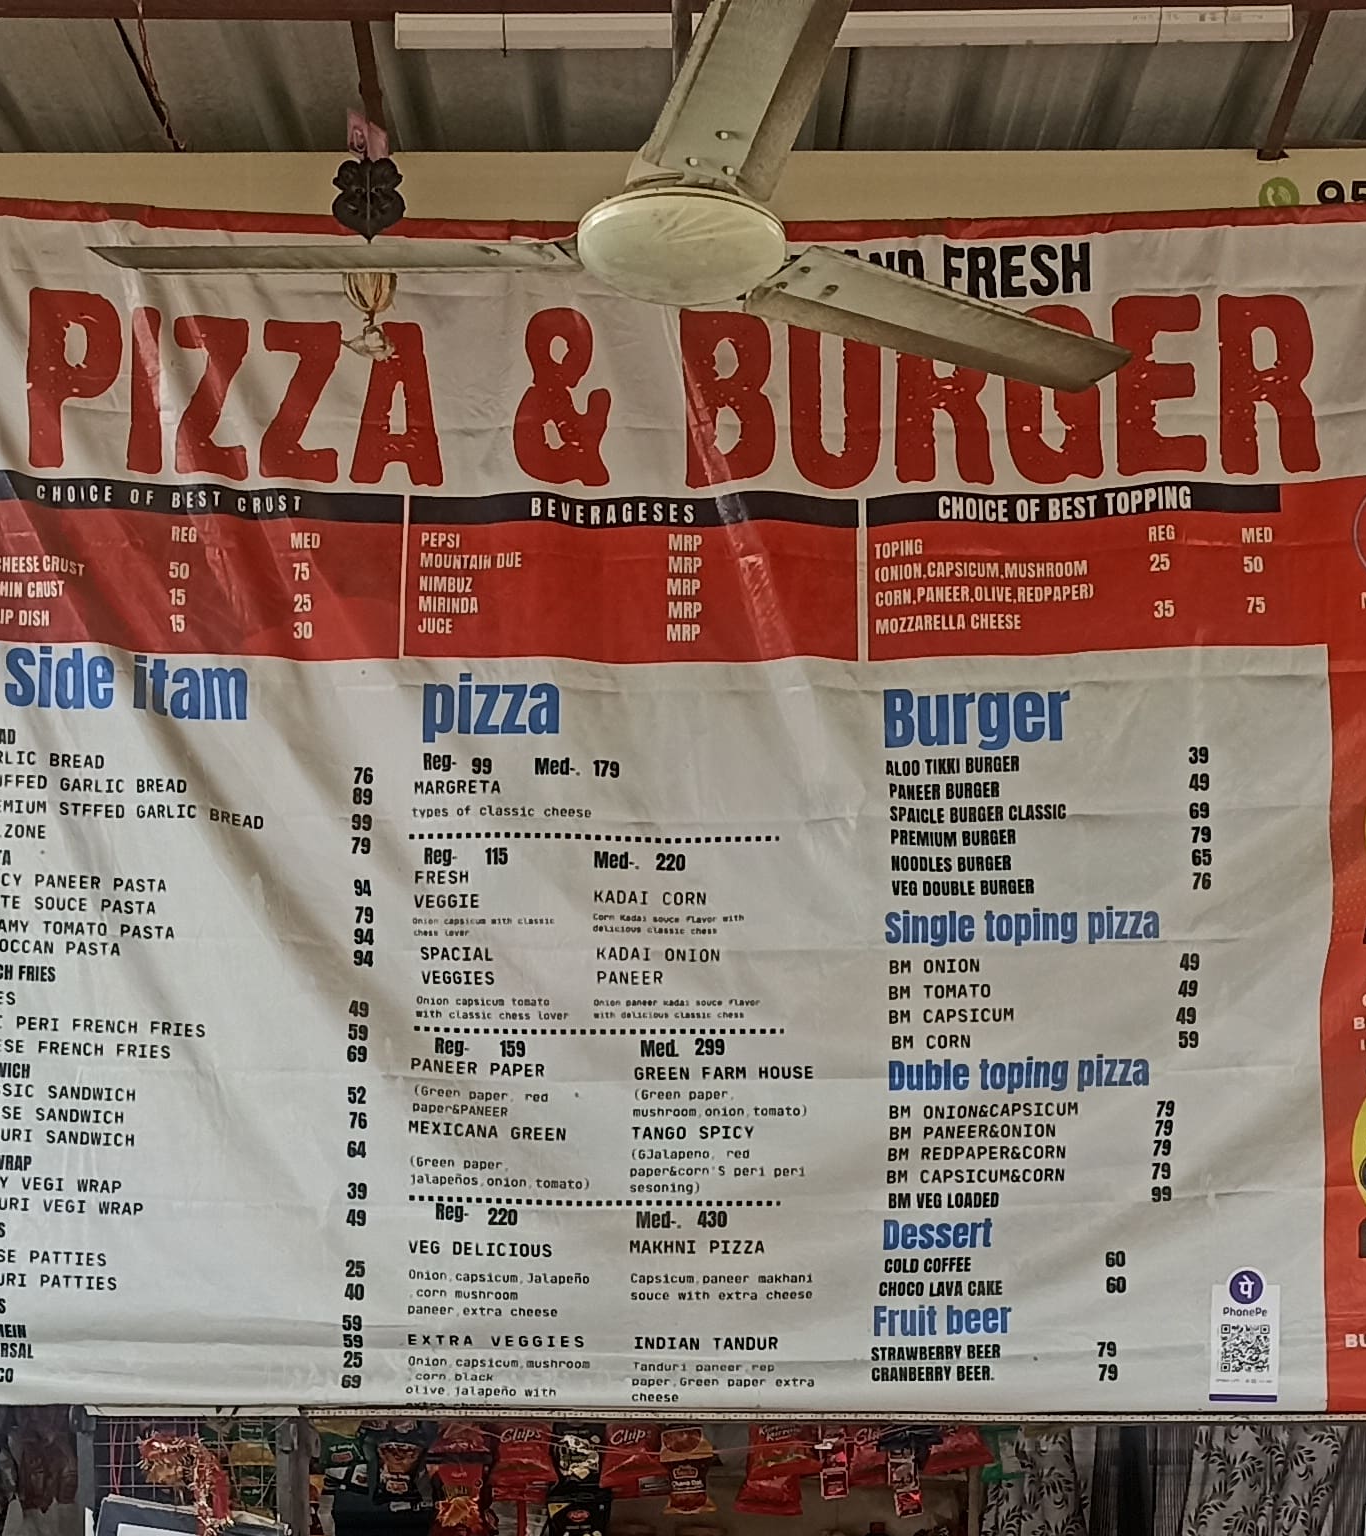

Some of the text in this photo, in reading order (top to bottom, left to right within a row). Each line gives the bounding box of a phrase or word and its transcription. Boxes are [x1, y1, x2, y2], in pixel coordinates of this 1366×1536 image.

[942, 243, 1091, 298] FRESH
[26, 287, 443, 487] PIZZA
[513, 306, 611, 486] &
[678, 291, 1321, 489] BURGER
[36, 484, 301, 514] CHOICE OF BEST CRUST
[530, 498, 696, 525] BEVERAGESES
[938, 486, 1191, 522] CHOICE OF BEST TOPPING
[421, 532, 460, 549] PEPSI
[419, 575, 473, 594] NIMBUZ
[418, 595, 479, 614] MIRINDA
[417, 617, 453, 634] JUCE
[4, 646, 248, 720] Side itam
[422, 672, 559, 743] pizza
[883, 688, 1070, 750] Burger
[885, 746, 1209, 777] ALOO TIKKI BURGER 39
[885, 906, 1160, 947] Single toping pizza
[889, 952, 1200, 975] BM ONION 49
[634, 1065, 814, 1081] GREEN FARM HOUSE
[888, 1055, 1150, 1091] Duble toping pizza
[629, 1239, 765, 1255] MAKHNI PIZZA
[883, 1218, 992, 1250] Dessert
[884, 1250, 1126, 1274] COLD COFFEE 60
[40, 1274, 117, 1291] PATTIES
[344, 1282, 365, 1301] 40
[873, 1304, 1011, 1337] Fruit beer
[1222, 1306, 1268, 1317] PhonePe
